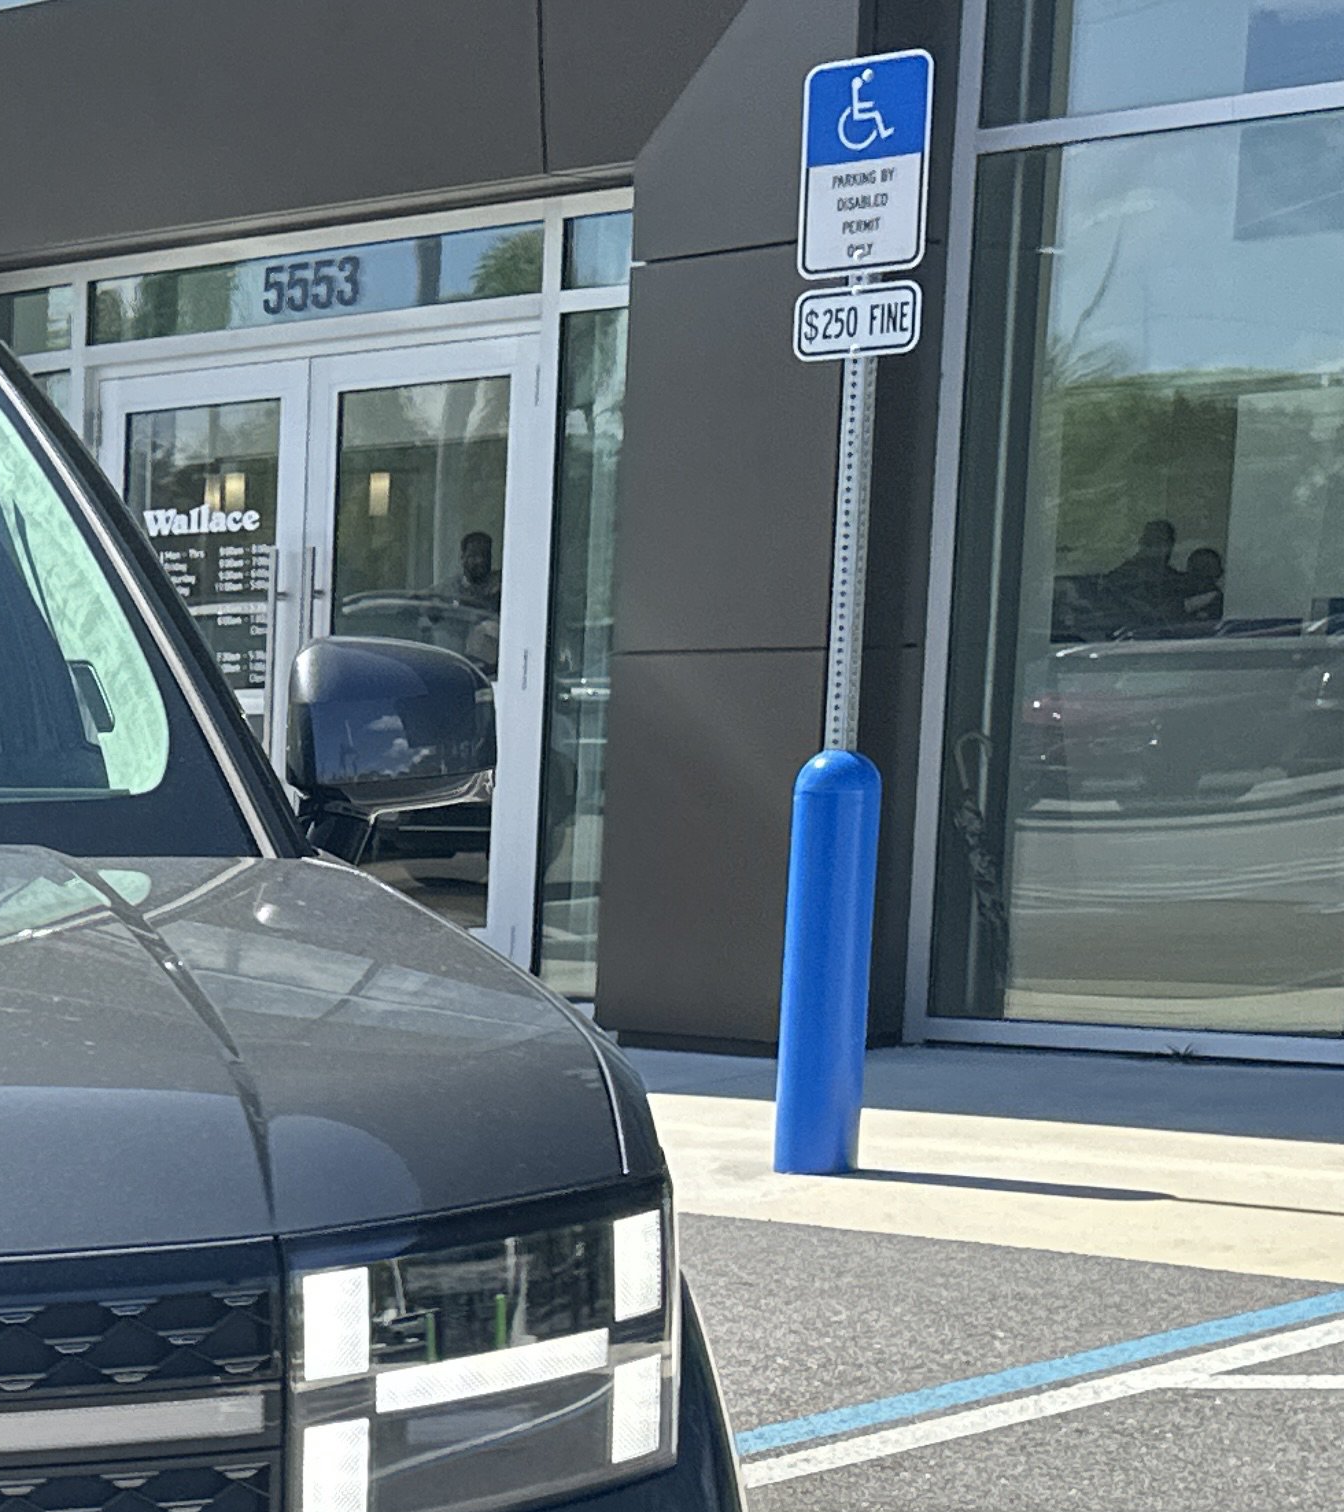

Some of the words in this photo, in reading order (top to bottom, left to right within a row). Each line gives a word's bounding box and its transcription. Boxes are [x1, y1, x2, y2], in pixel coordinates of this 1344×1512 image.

[832, 170, 877, 189] PARKING
[881, 167, 895, 183] BY
[837, 193, 888, 212] DISABLED
[842, 217, 881, 235] PERMIT
[263, 256, 360, 315] 5553
[804, 307, 858, 344] $250
[869, 301, 910, 336] FINE
[143, 504, 260, 537] Wallace
